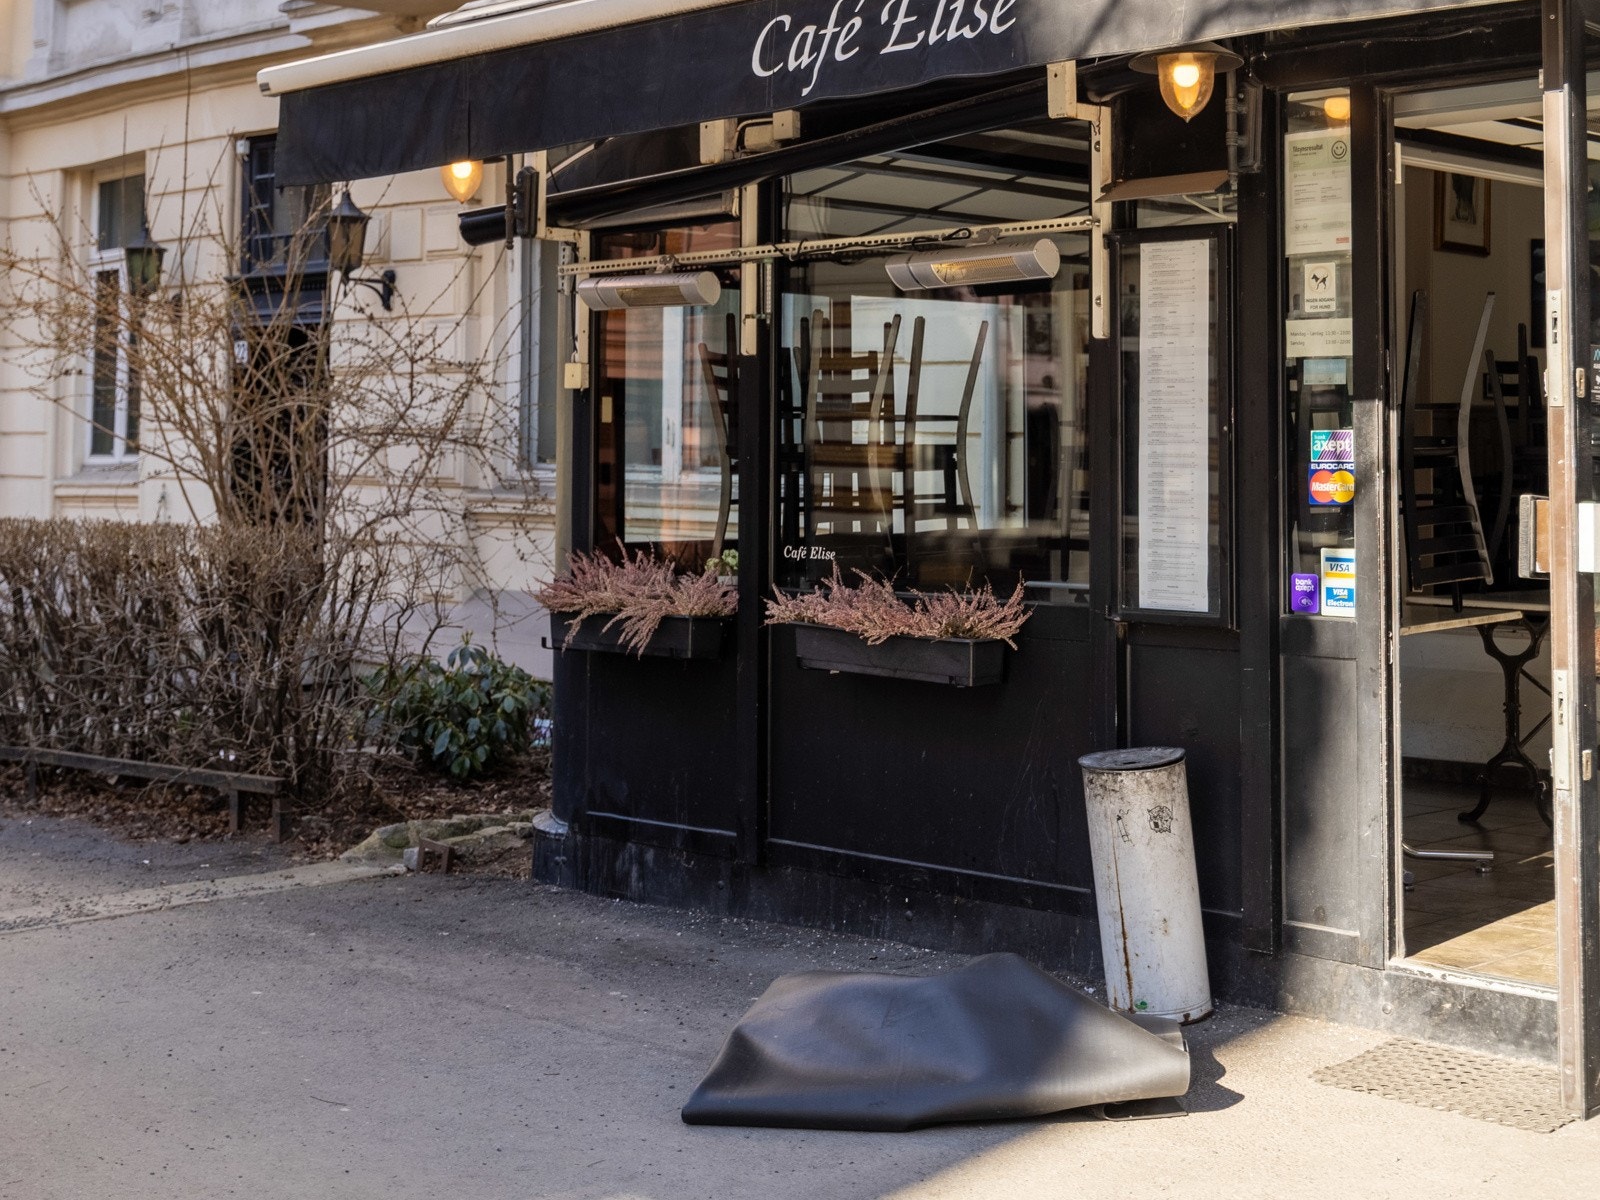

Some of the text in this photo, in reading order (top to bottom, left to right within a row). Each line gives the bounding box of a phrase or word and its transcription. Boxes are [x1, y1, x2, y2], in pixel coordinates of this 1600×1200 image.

[1313, 437, 1352, 455] axept
[1311, 482, 1354, 491] MasterCard
[783, 545, 836, 561] Café Elise
[1329, 563, 1350, 572] VISA
